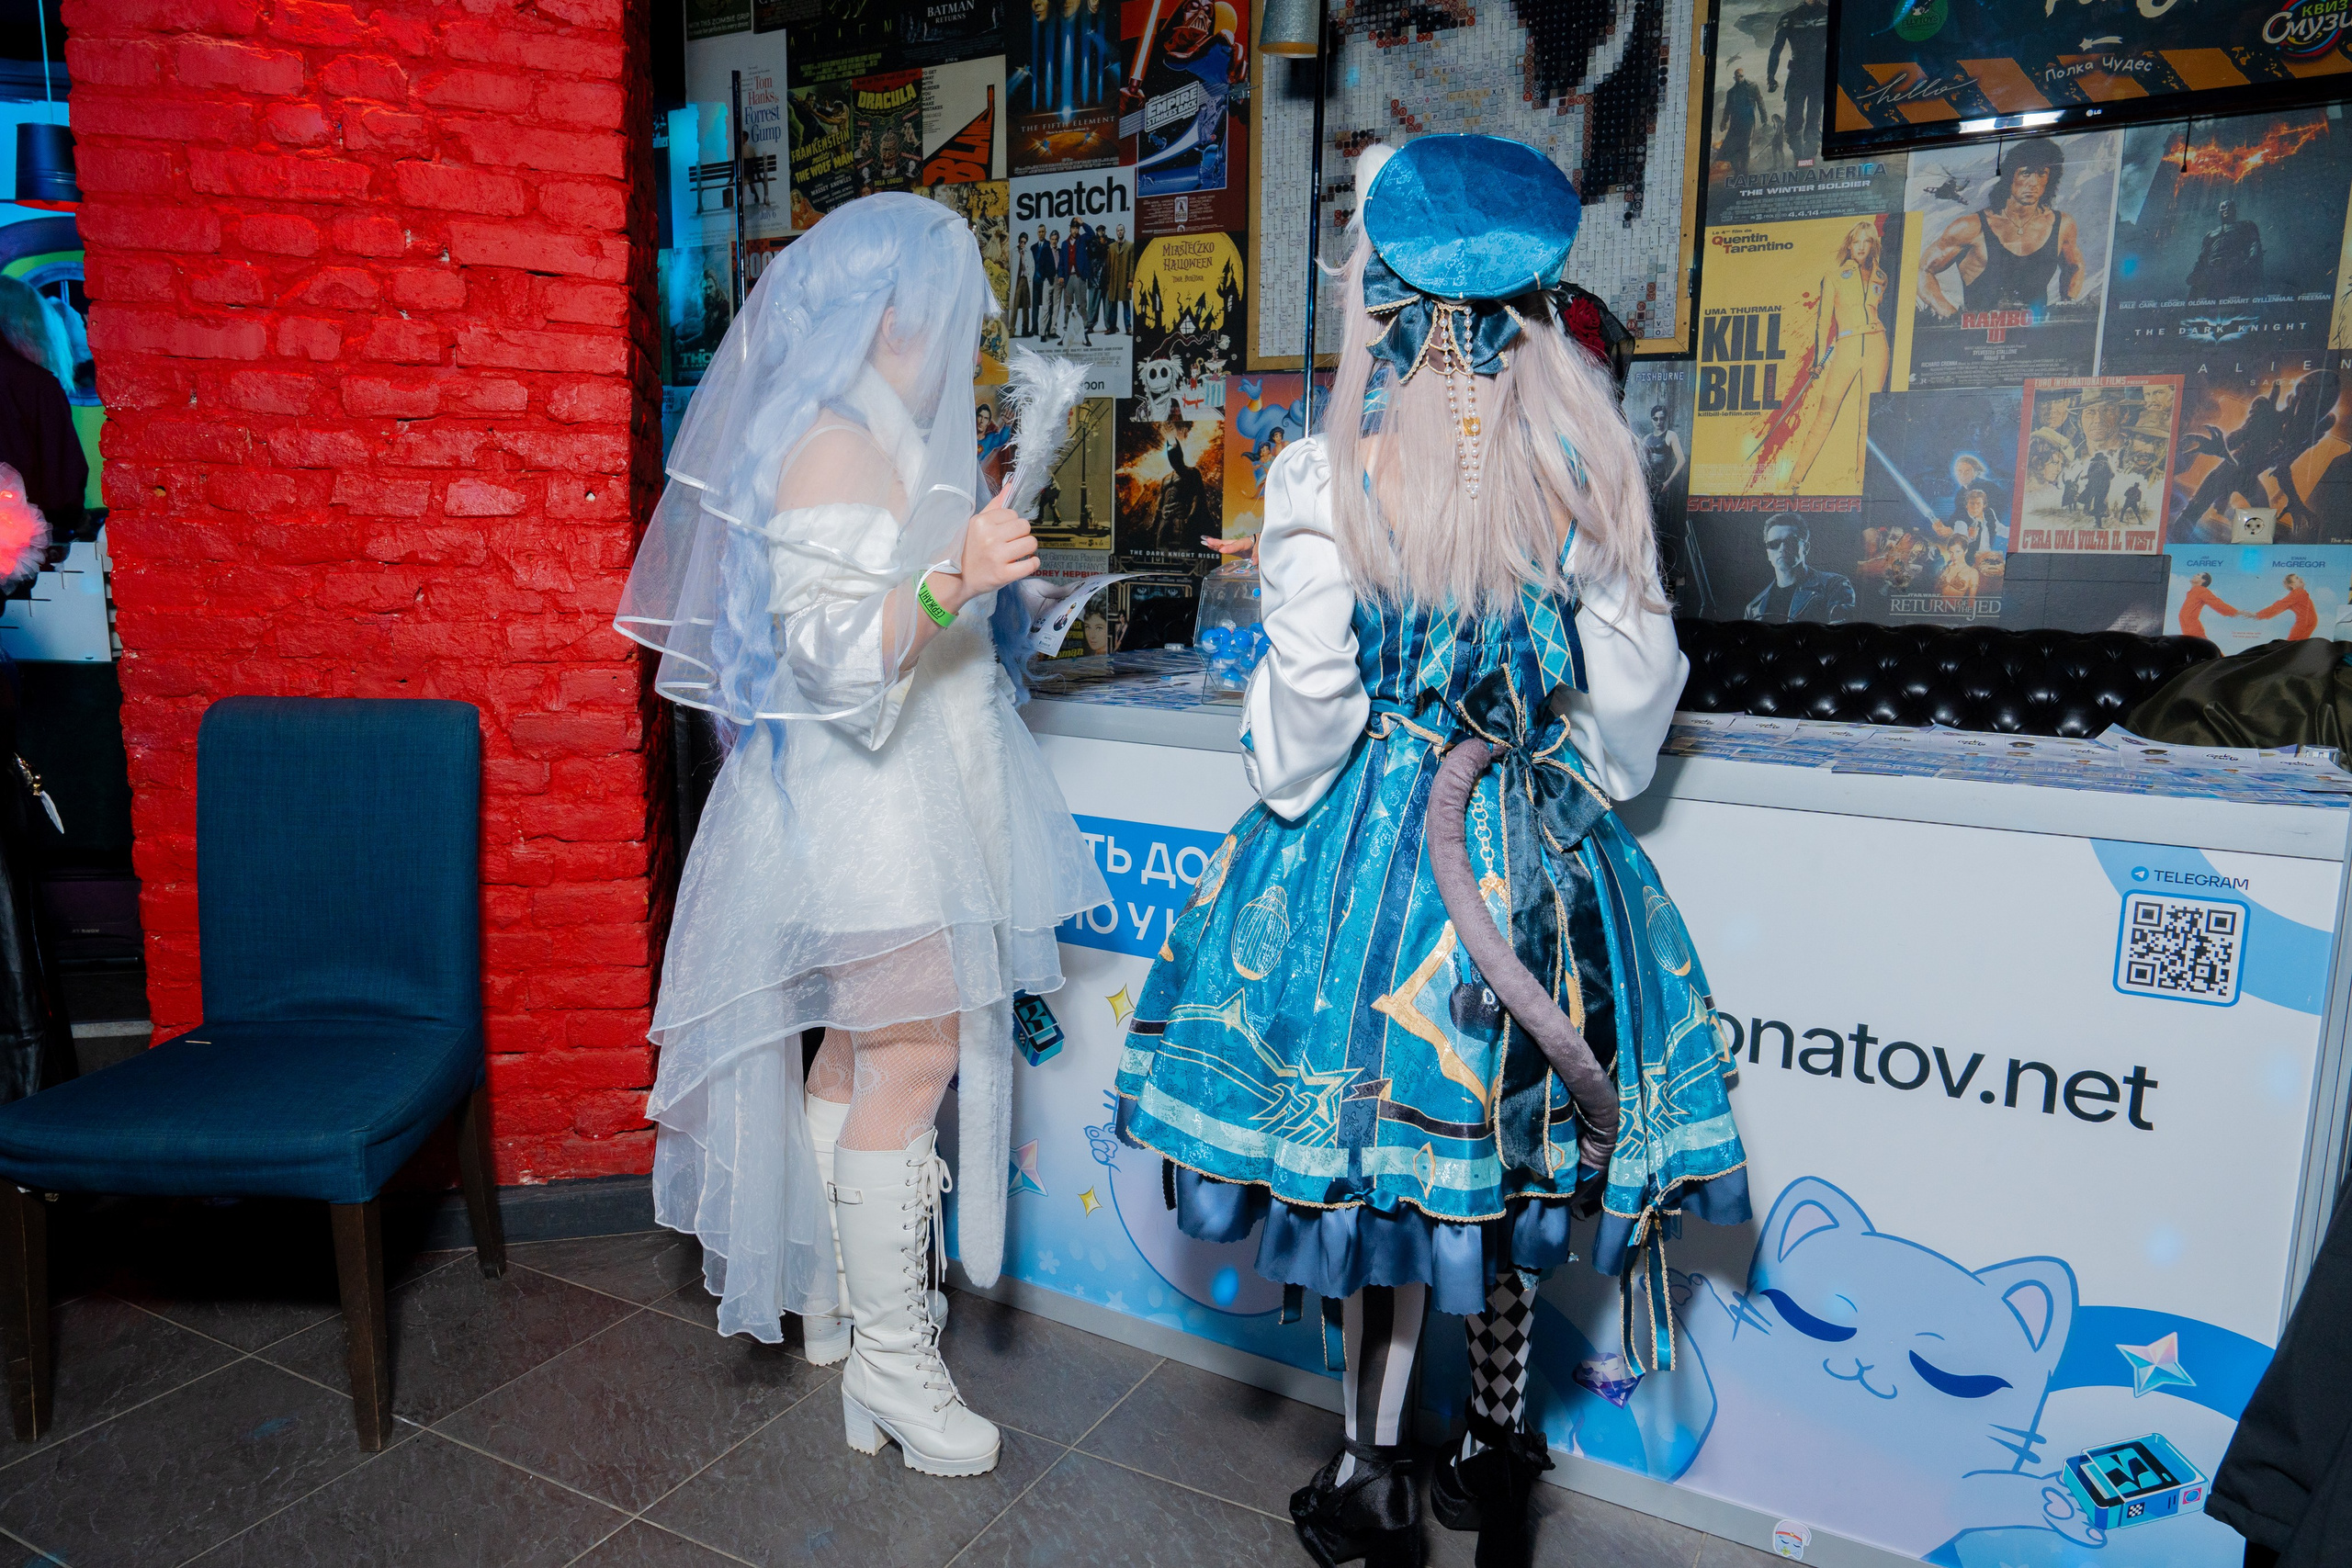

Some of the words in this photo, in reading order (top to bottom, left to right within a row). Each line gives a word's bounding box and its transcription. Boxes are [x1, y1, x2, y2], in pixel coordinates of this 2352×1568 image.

[927, 0, 975, 17] BATMAN
[2301, 0, 2349, 17] КВИЗ
[712, 15, 735, 25] ZOMBIE
[737, 12, 751, 21] GRIP
[935, 13, 967, 24] RETURNS
[2045, 62, 2095, 82] Полка
[2102, 56, 2153, 73] Чудес
[755, 75, 772, 90] Tom
[1857, 73, 1978, 105] hello
[748, 90, 775, 106] Hanks
[857, 84, 917, 109] DRACULA
[1149, 86, 1198, 117] EMPIRE
[744, 106, 781, 125] Forrest
[1147, 107, 1178, 127] STRIKES
[1177, 98, 1198, 116] BACK
[1021, 124, 1038, 132] THE
[1073, 116, 1115, 127] ELEMENT
[751, 125, 781, 143] Gump
[791, 130, 851, 164] FRANKENSTEIN
[795, 170, 810, 184] THE
[810, 160, 831, 177] WOLF
[833, 151, 854, 168] MAN
[1798, 159, 1815, 167] MARVEL
[1724, 169, 1800, 189] CAPTAIN
[1804, 162, 1888, 183] AMERICA
[1767, 186, 1815, 195] WINTER
[1817, 179, 1871, 191] SOLDIER
[1016, 176, 1131, 220] snatch.
[1788, 209, 1820, 218] 4.4.14
[1712, 232, 1769, 247] Quentin
[1161, 240, 1215, 257] MIASTECZKO
[1723, 242, 1794, 254] Tarantino
[1163, 256, 1213, 271] HALLOWEEN
[2252, 296, 2295, 304] GYLLENHAAL
[2298, 294, 2332, 302] FREEMAN
[1730, 305, 1782, 314] THURMAN
[1961, 310, 2033, 330] RAMBO
[1986, 328, 2007, 344] III
[2134, 328, 2165, 336] THE
[2178, 326, 2224, 335] DARK
[2238, 322, 2308, 333] KNIGHT
[1701, 313, 1786, 363] KILL
[680, 352, 715, 365] THO
[2198, 359, 2352, 374] ALIEN
[1635, 372, 1685, 382] FISHBURNE
[2034, 378, 2052, 388] EURO
[2053, 378, 2104, 387] INTERNATIONAL
[2106, 377, 2127, 386] FILMS
[2250, 377, 2299, 387] SAGA
[1698, 364, 1782, 412] BILL
[1687, 497, 1862, 513] SCHWARZENEGGER
[2054, 530, 2075, 550] UNA
[2077, 530, 2109, 550] VOLTA
[2110, 530, 2122, 550] IL
[2125, 531, 2156, 550] WEST
[1891, 599, 1957, 613] RETURN
[2154, 869, 2250, 891] TELEGRAM
[1127, 902, 1156, 941] У
